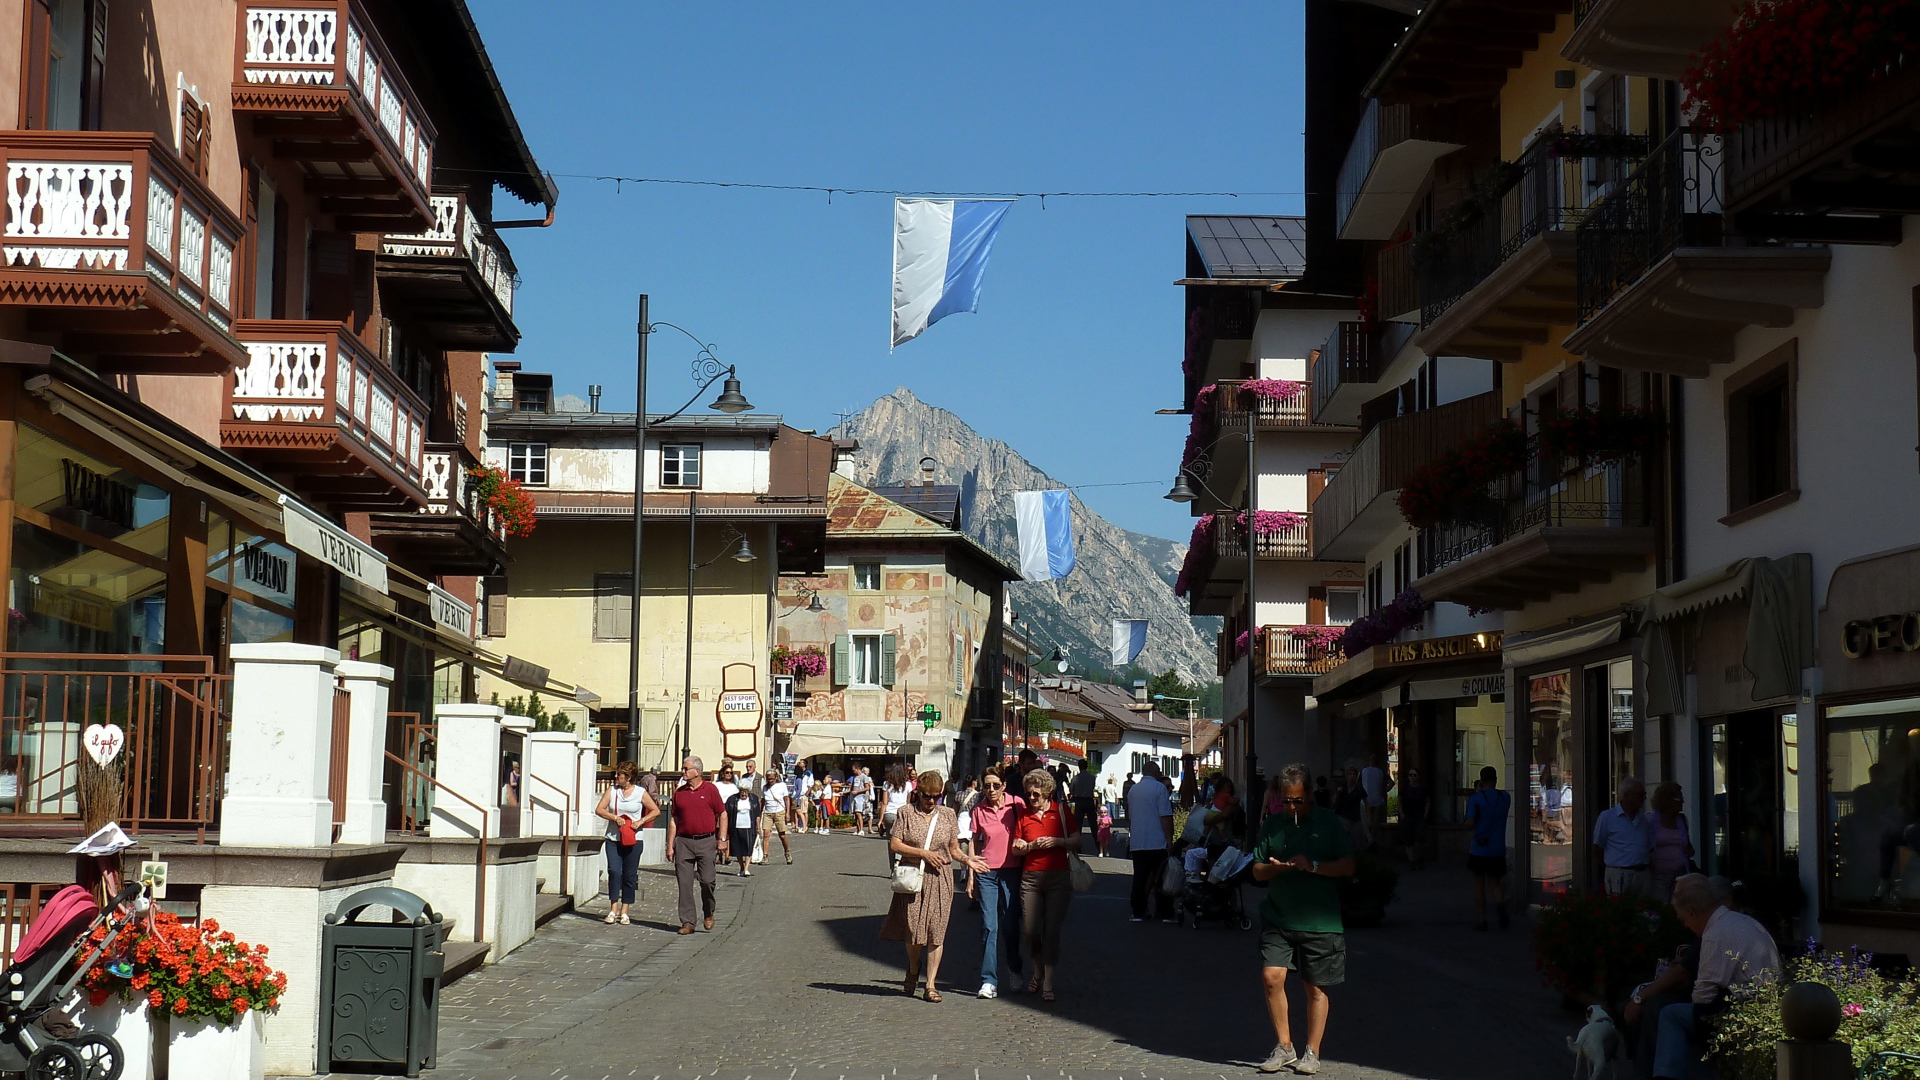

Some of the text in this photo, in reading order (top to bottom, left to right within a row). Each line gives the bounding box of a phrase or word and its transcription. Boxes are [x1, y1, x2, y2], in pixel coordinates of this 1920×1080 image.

[62, 458, 136, 531] VERNI
[244, 541, 289, 595] VERNI
[318, 528, 363, 578] VERNI
[439, 598, 465, 632] VERNI
[1388, 643, 1417, 663] ITAS
[724, 702, 756, 711] OUTLET
[776, 679, 791, 702] T
